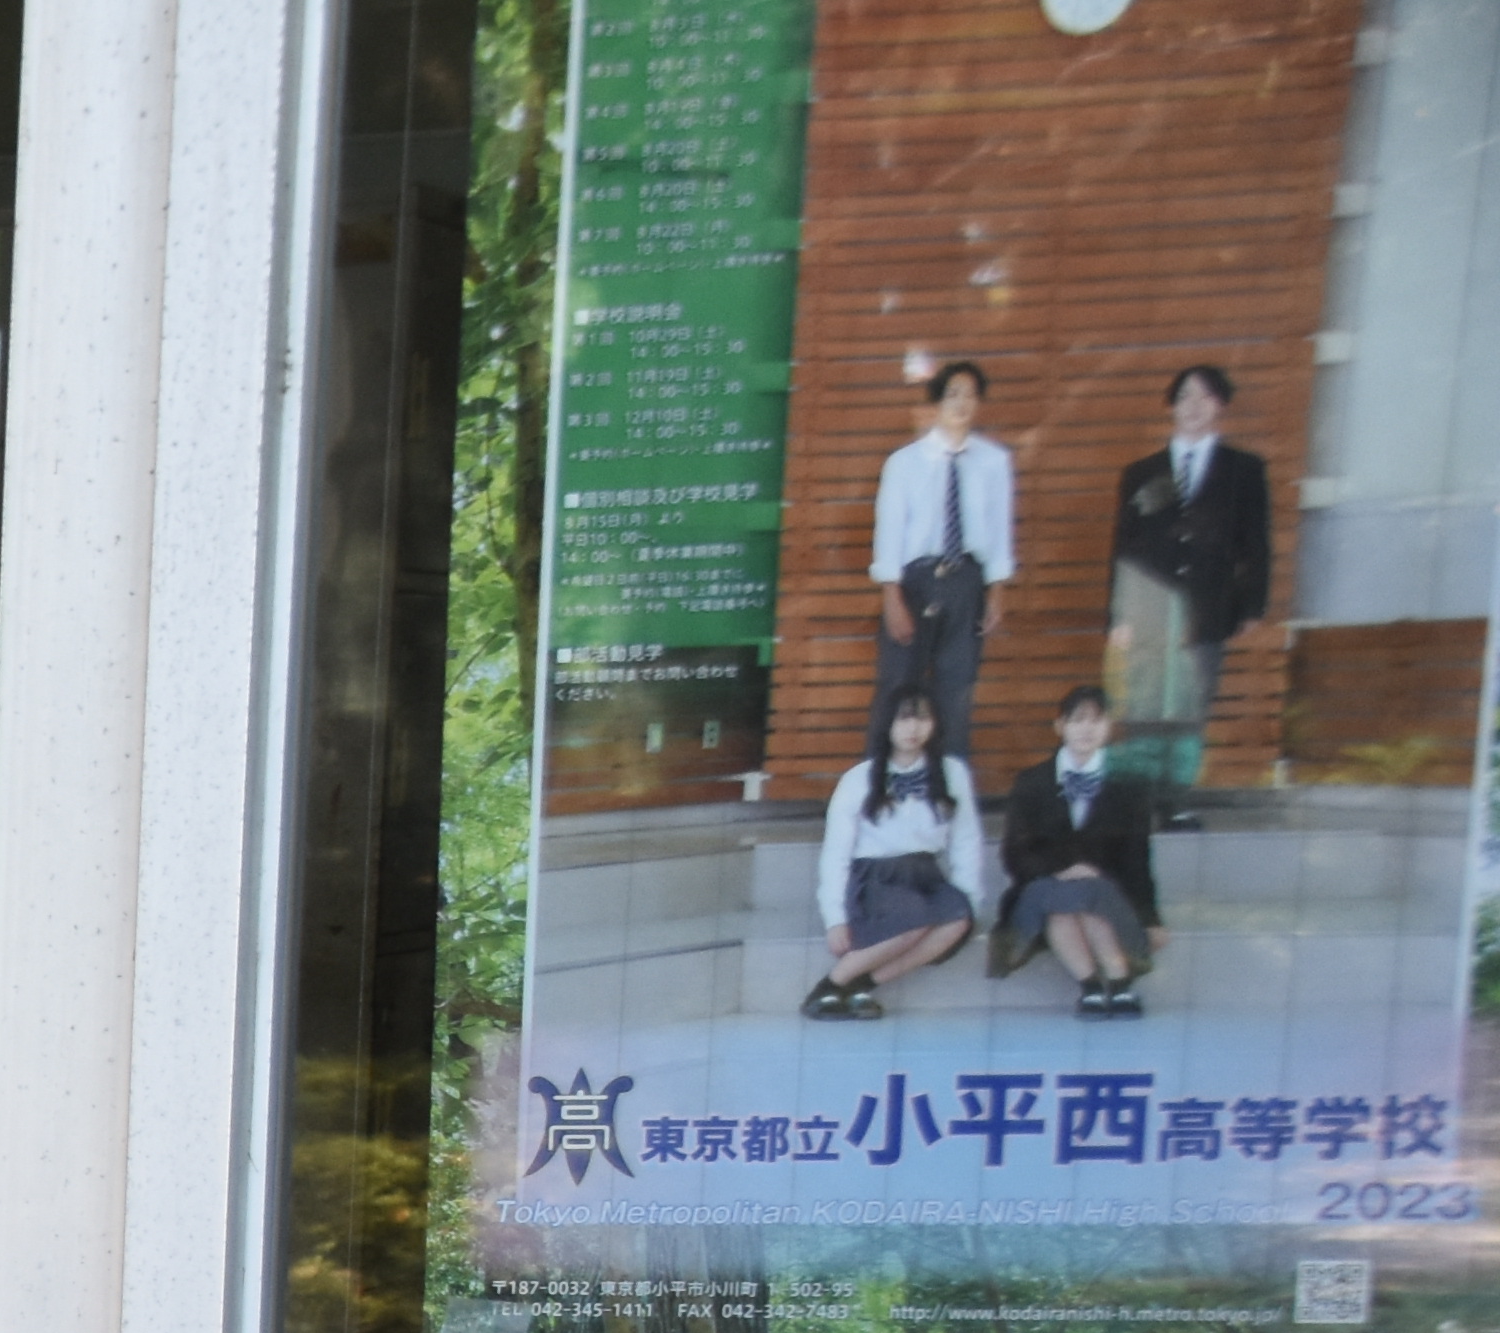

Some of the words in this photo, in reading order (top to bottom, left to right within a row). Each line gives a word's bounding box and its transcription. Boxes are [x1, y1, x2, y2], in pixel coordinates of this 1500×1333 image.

[641, 1072, 1450, 1167] 東京都立小平西高等学校
[496, 1200, 590, 1227] Tokyo
[601, 1200, 801, 1226] Metropolitan
[1084, 1199, 1159, 1227] High
[1316, 1182, 1476, 1221] 2023
[601, 1279, 758, 1298] 東京都小平市小川町
[492, 1302, 523, 1317] TEL
[530, 1302, 653, 1318] 042-345-1411
[677, 1302, 713, 1318] FAX
[720, 1303, 850, 1320] 042-342-7483
